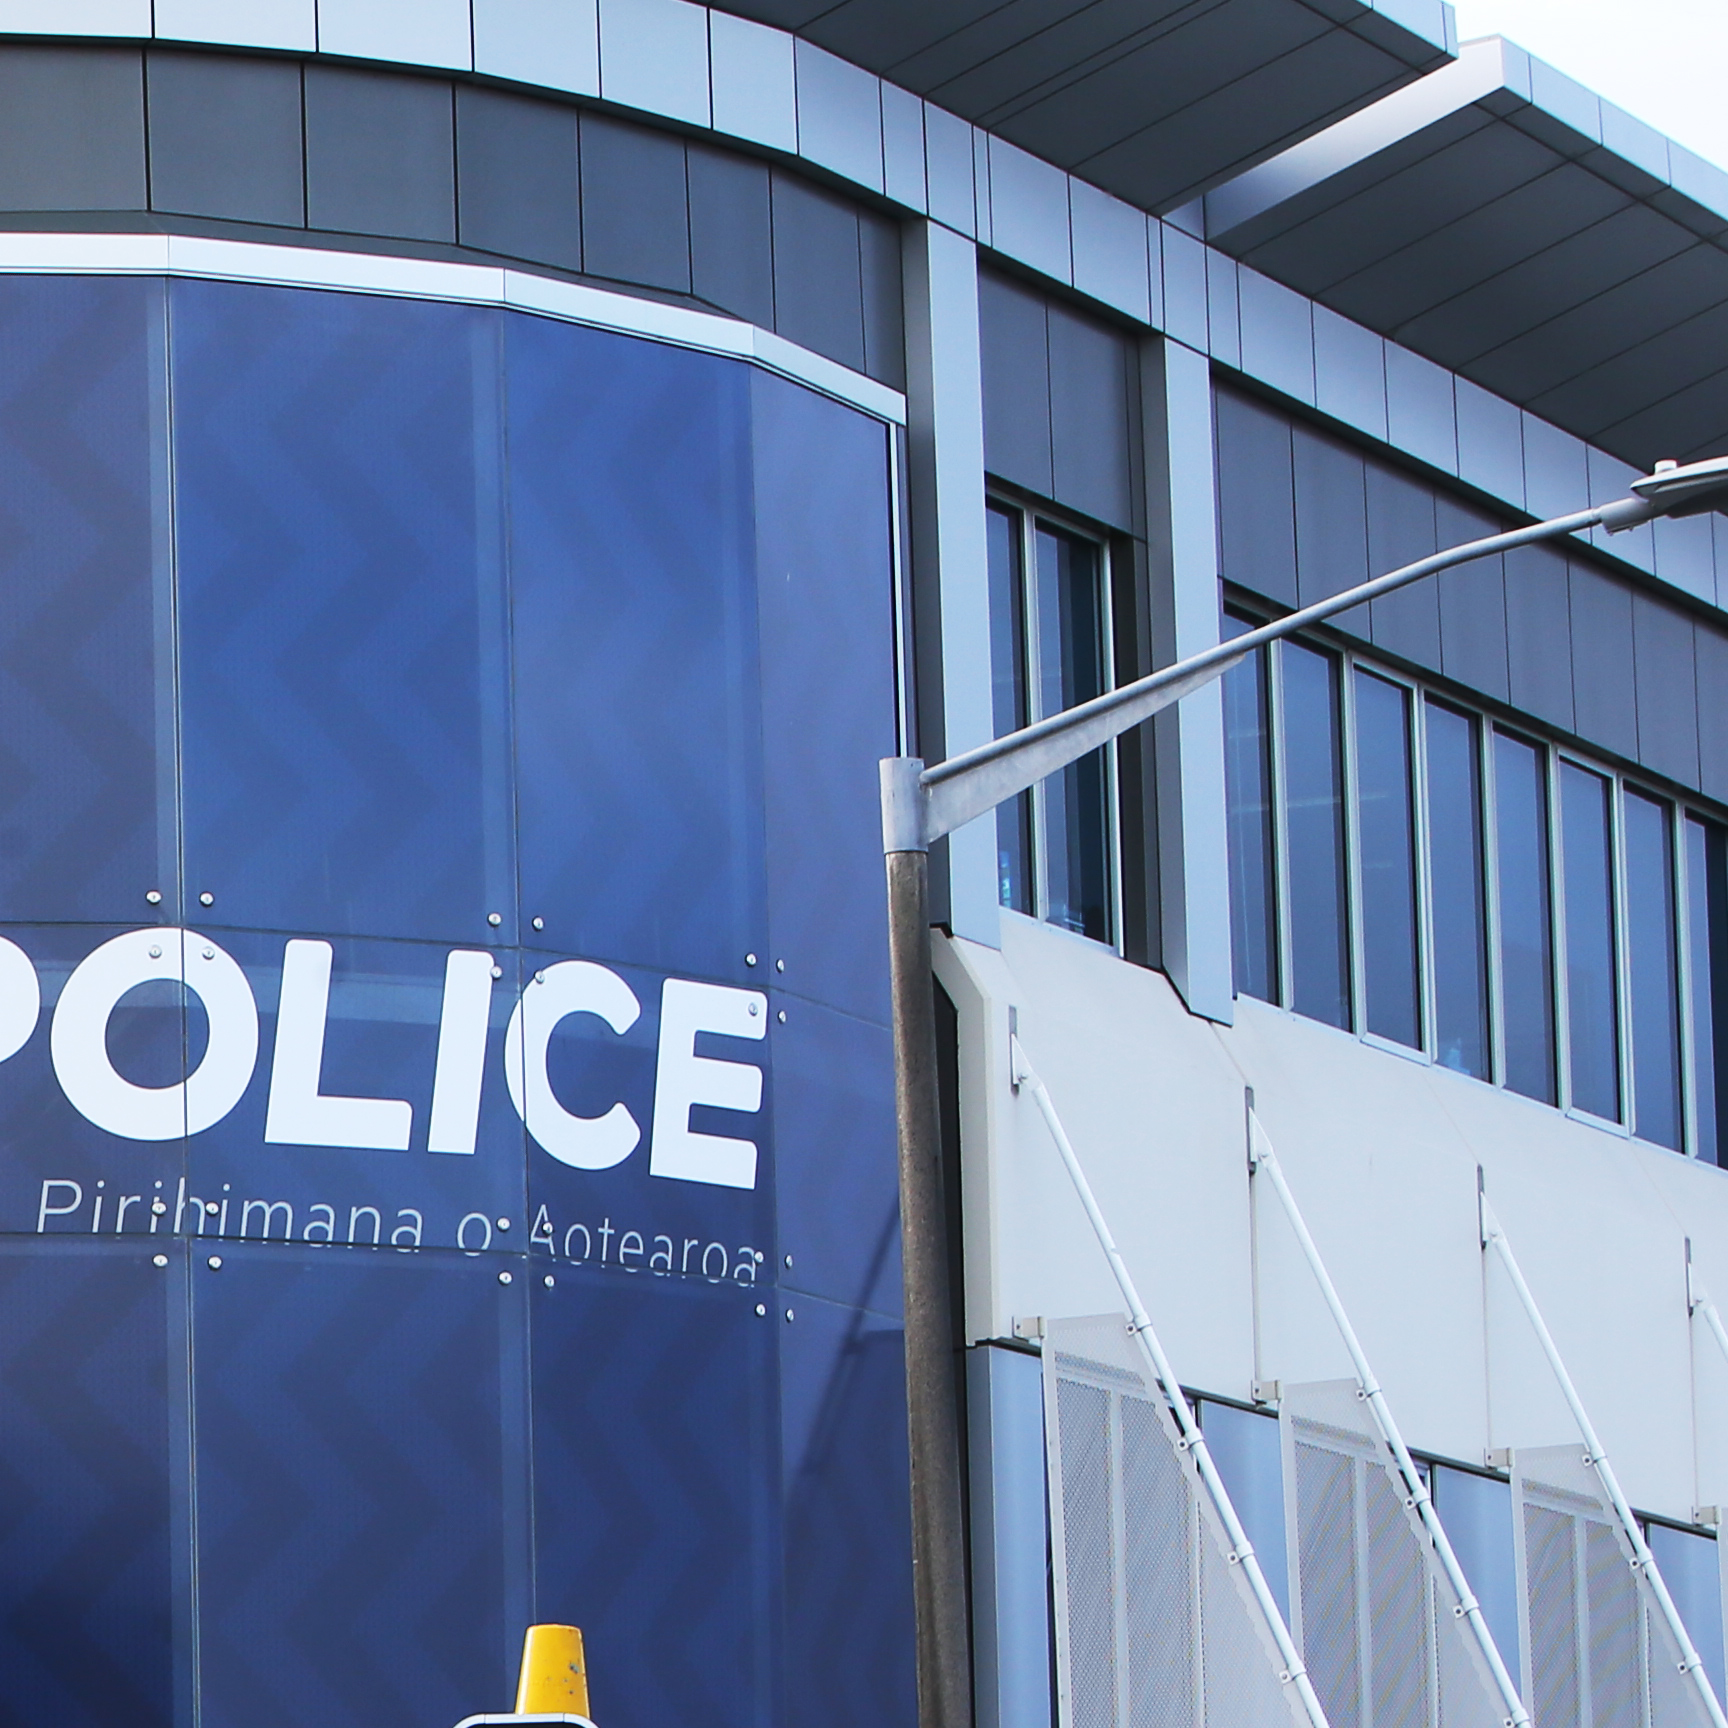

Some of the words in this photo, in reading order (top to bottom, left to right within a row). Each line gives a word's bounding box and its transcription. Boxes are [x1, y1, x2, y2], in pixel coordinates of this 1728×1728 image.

[37, 1177, 423, 1253] Pirihimana
[456, 1212, 492, 1257] o
[530, 1203, 757, 1288] Aotearoa
